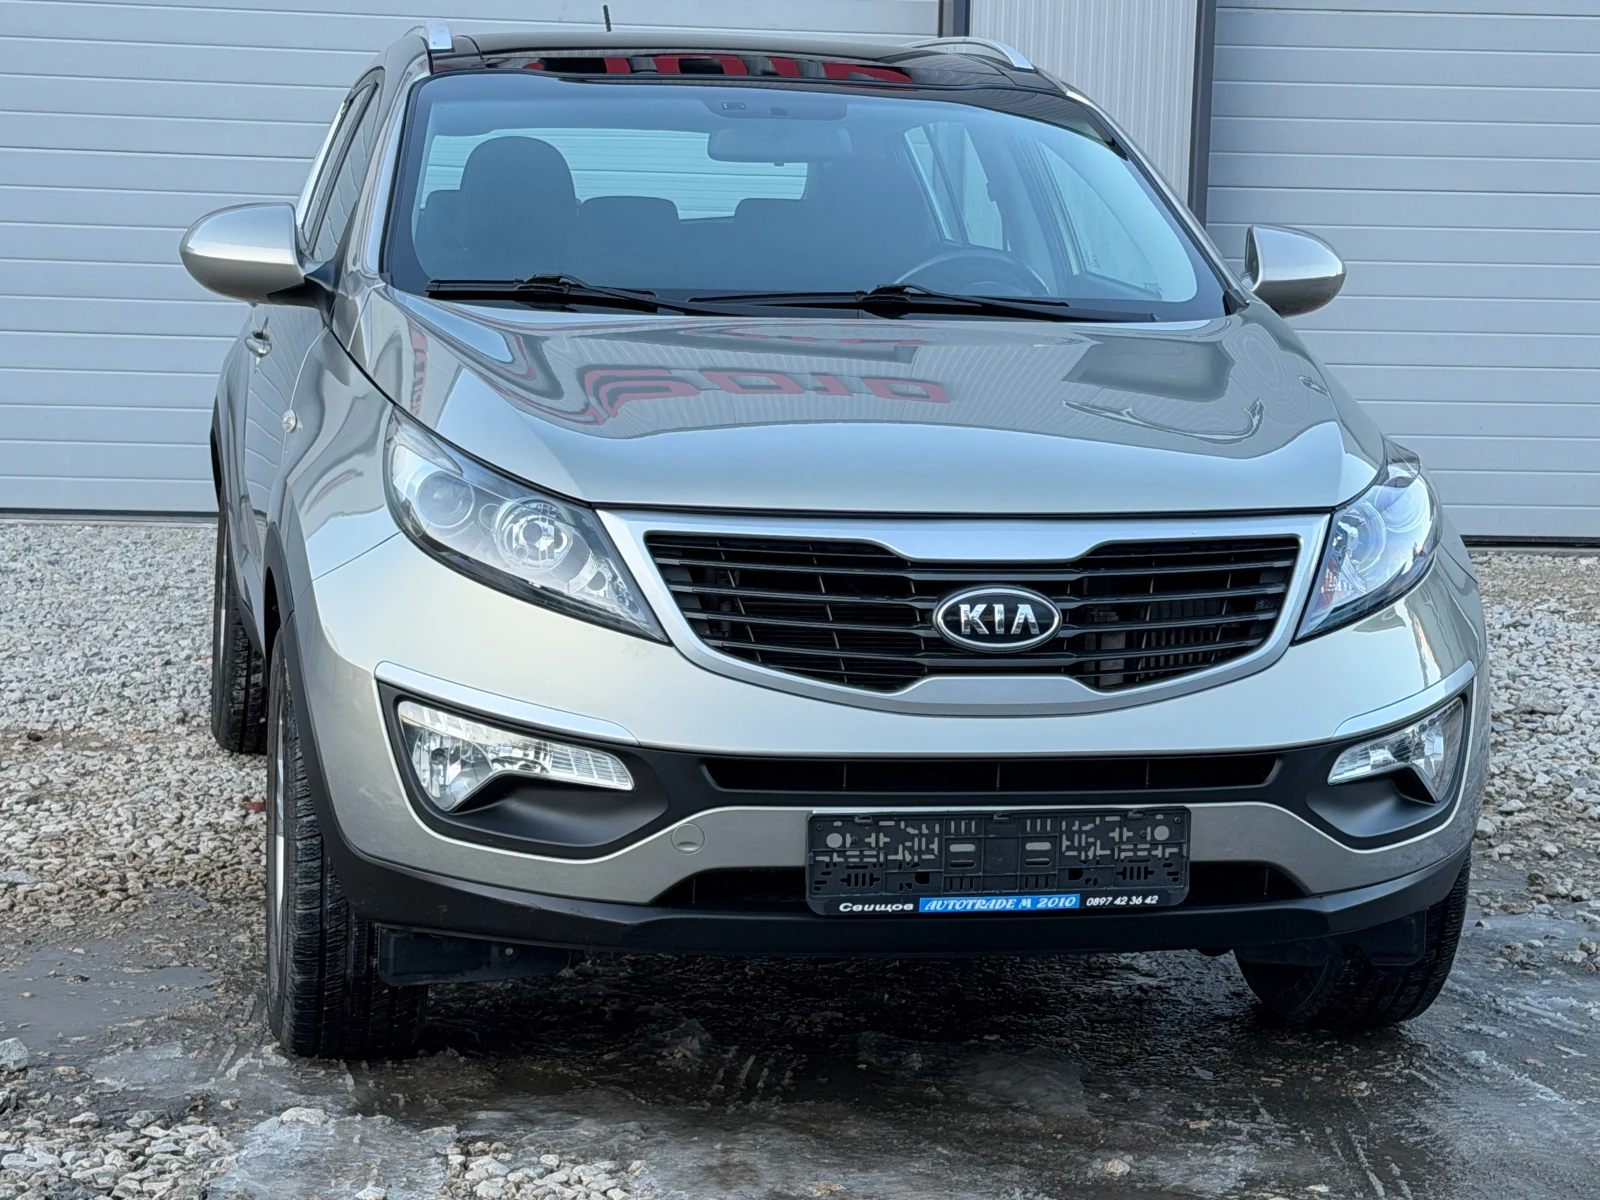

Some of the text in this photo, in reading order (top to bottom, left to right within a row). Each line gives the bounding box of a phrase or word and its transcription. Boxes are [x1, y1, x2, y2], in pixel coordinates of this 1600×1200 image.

[958, 603, 1041, 635] KIA
[838, 895, 1158, 912] Свищов AUTOTRADE M 2010 0897 42 36 42
